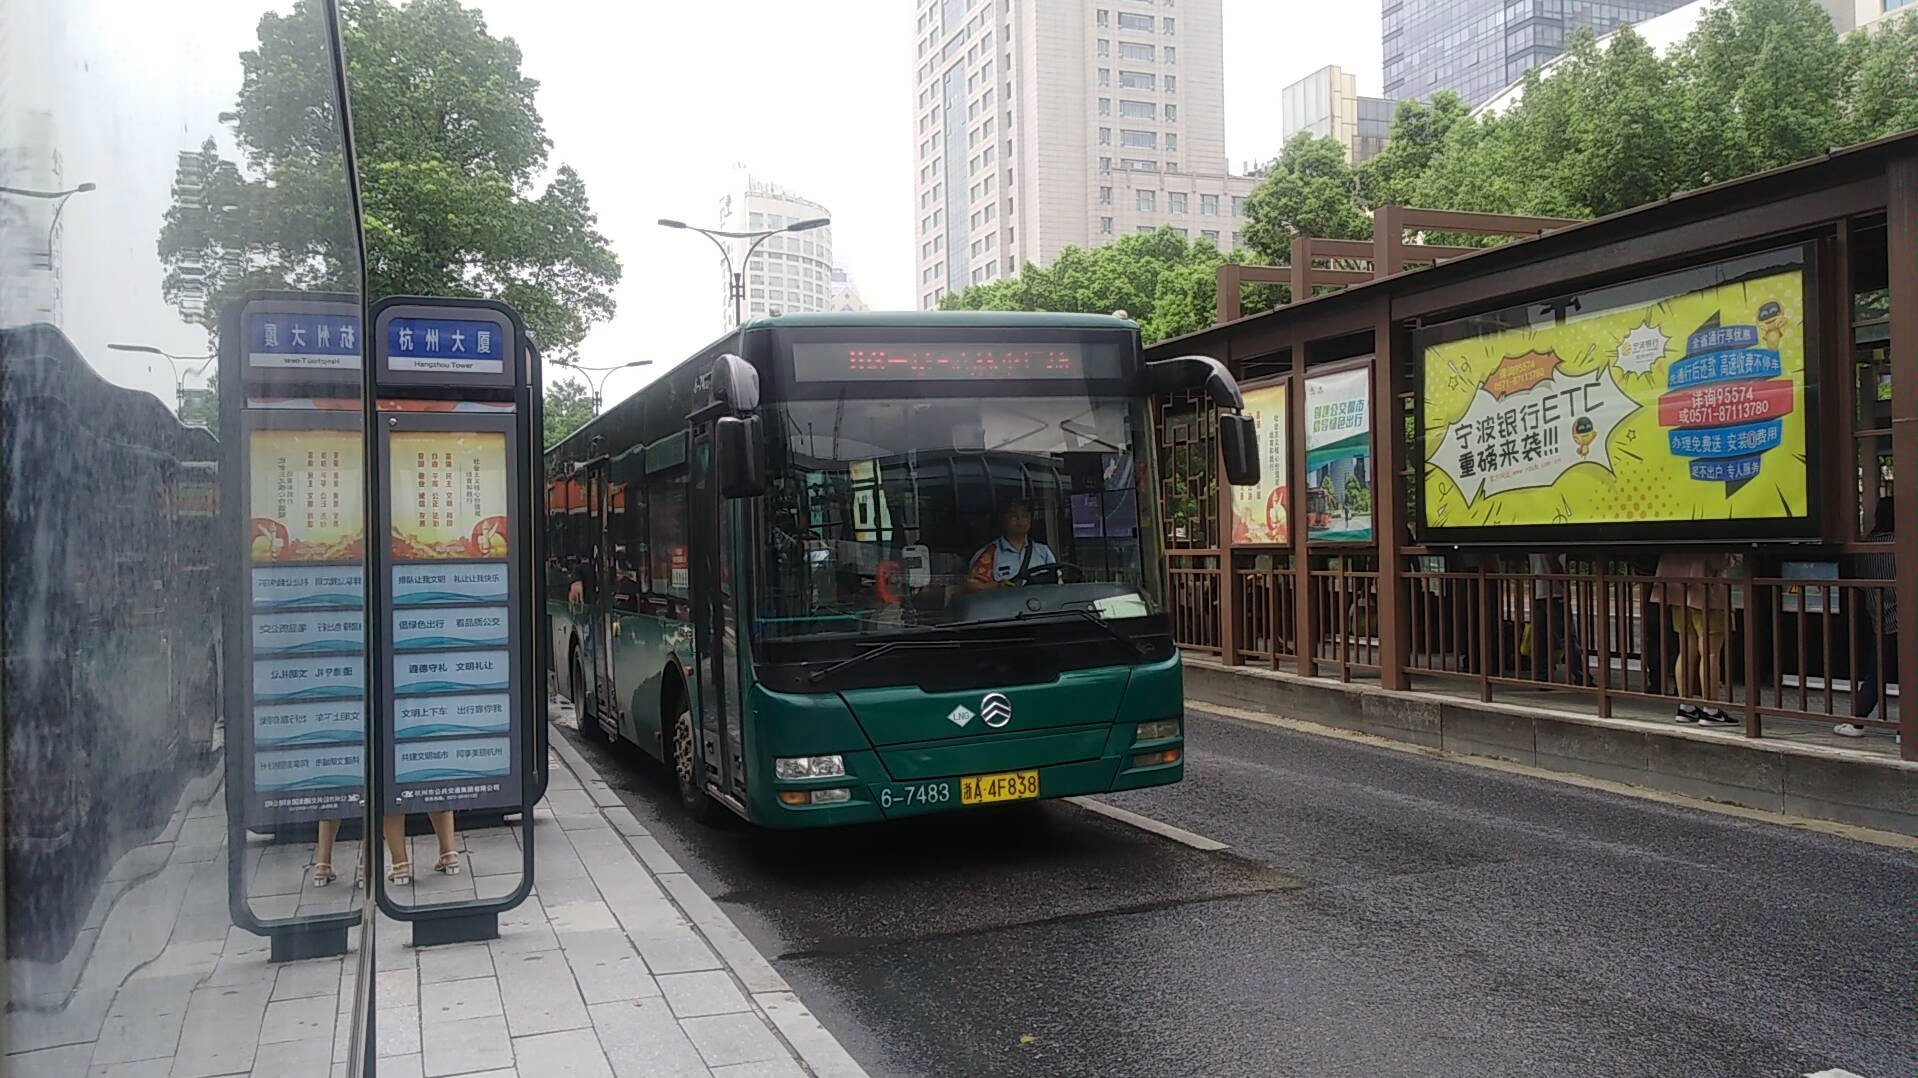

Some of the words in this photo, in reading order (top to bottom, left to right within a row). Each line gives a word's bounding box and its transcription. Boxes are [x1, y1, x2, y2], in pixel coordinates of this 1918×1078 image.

[399, 327, 491, 354] 杭州大厦
[414, 361, 449, 369] Hangzhou
[1692, 387, 1753, 408] 详询95574
[1455, 382, 1604, 450] 宁波银行ETC
[1679, 400, 1769, 424] 或0571-87113780
[1672, 434, 1722, 453] 办理免费送
[1727, 426, 1777, 451] 安装0费用
[1727, 462, 1759, 479] 专人服务
[455, 661, 494, 672] 文明礼让
[401, 707, 448, 719] 文明上下车
[953, 712, 970, 721] LNG
[881, 783, 950, 808] 6-7483
